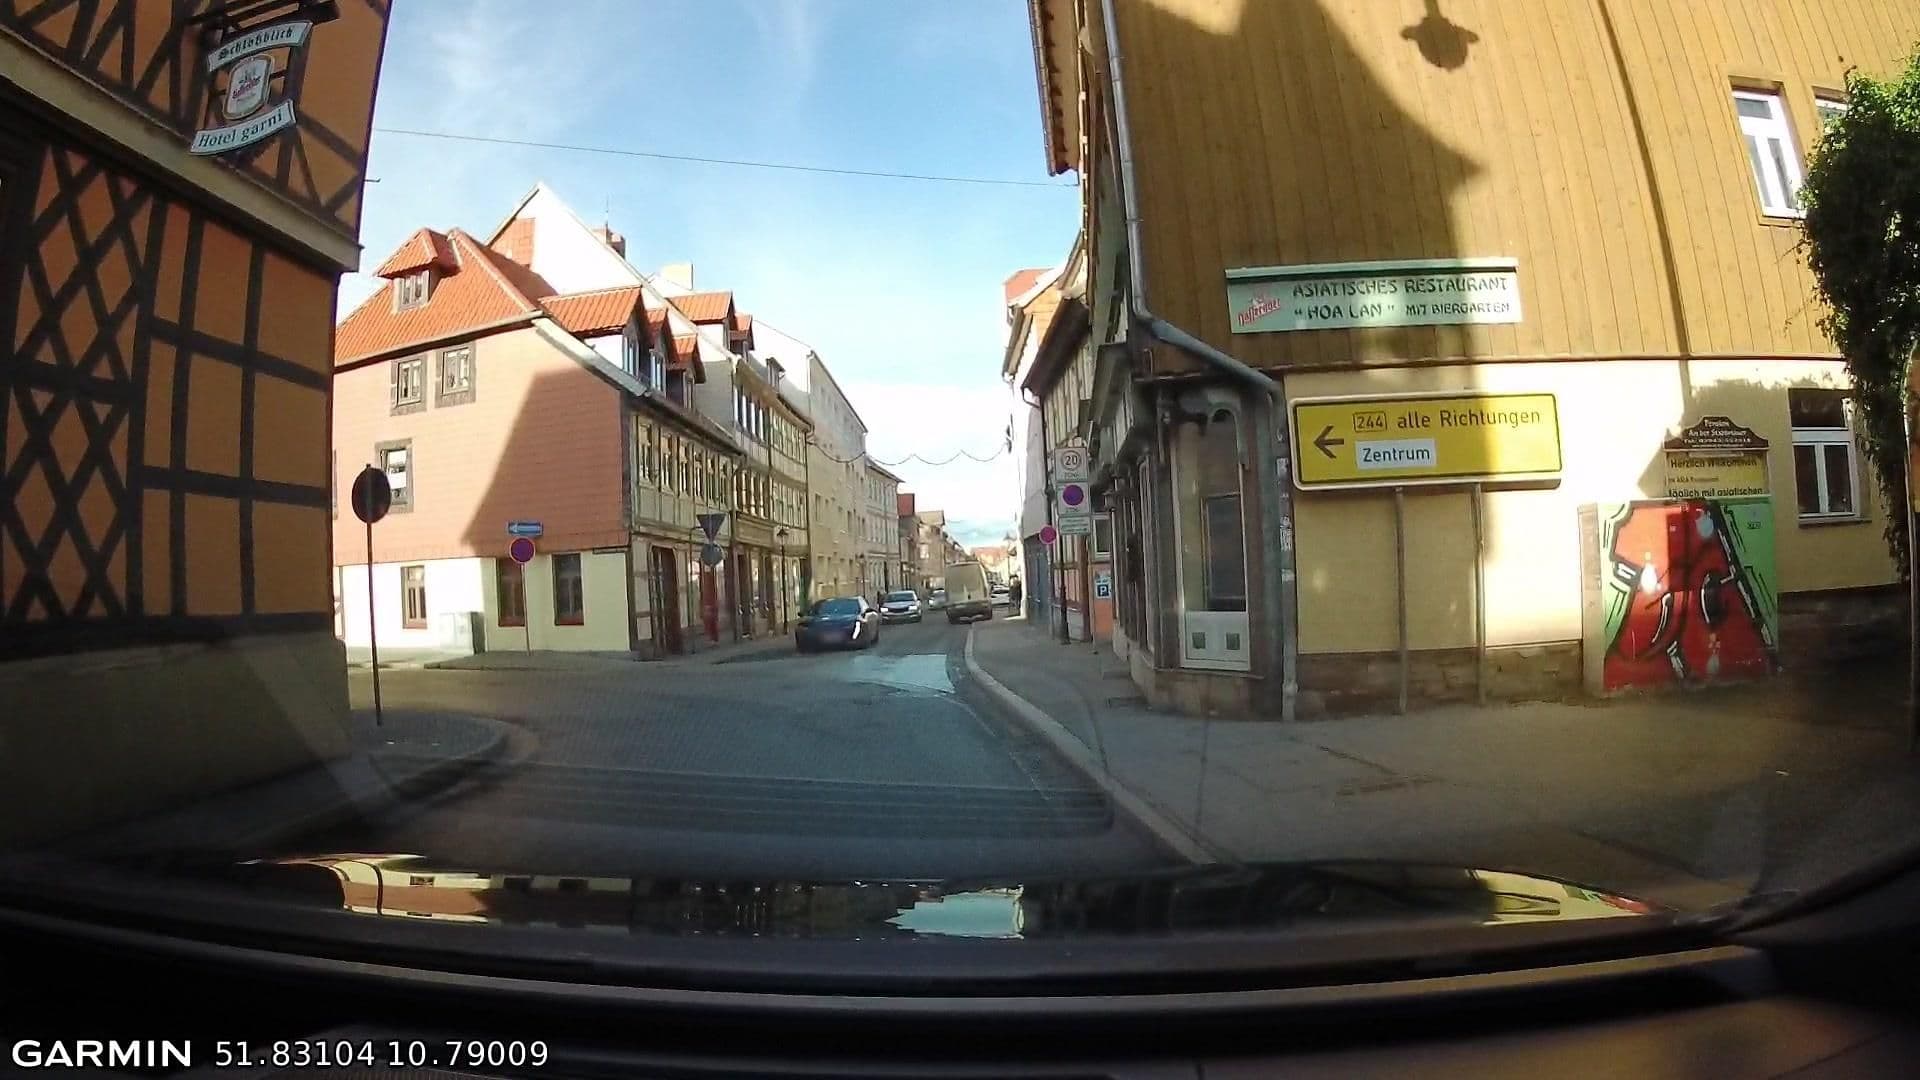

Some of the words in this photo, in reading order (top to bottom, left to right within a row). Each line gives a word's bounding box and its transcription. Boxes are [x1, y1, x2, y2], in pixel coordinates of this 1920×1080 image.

[198, 129, 236, 148] Hotel
[241, 108, 283, 141] garni
[1292, 279, 1398, 298] ASIATISCHES
[1404, 277, 1509, 294] RESTAURANT
[1405, 304, 1427, 316] MIT
[1431, 302, 1510, 315] BIERGARTEN
[1356, 415, 1384, 429] 244
[1397, 410, 1431, 429] alle
[1440, 409, 1541, 430] Richtungen
[1065, 455, 1078, 466] 20
[1362, 447, 1431, 463] Zentrum
[1701, 487, 1716, 497] mit
